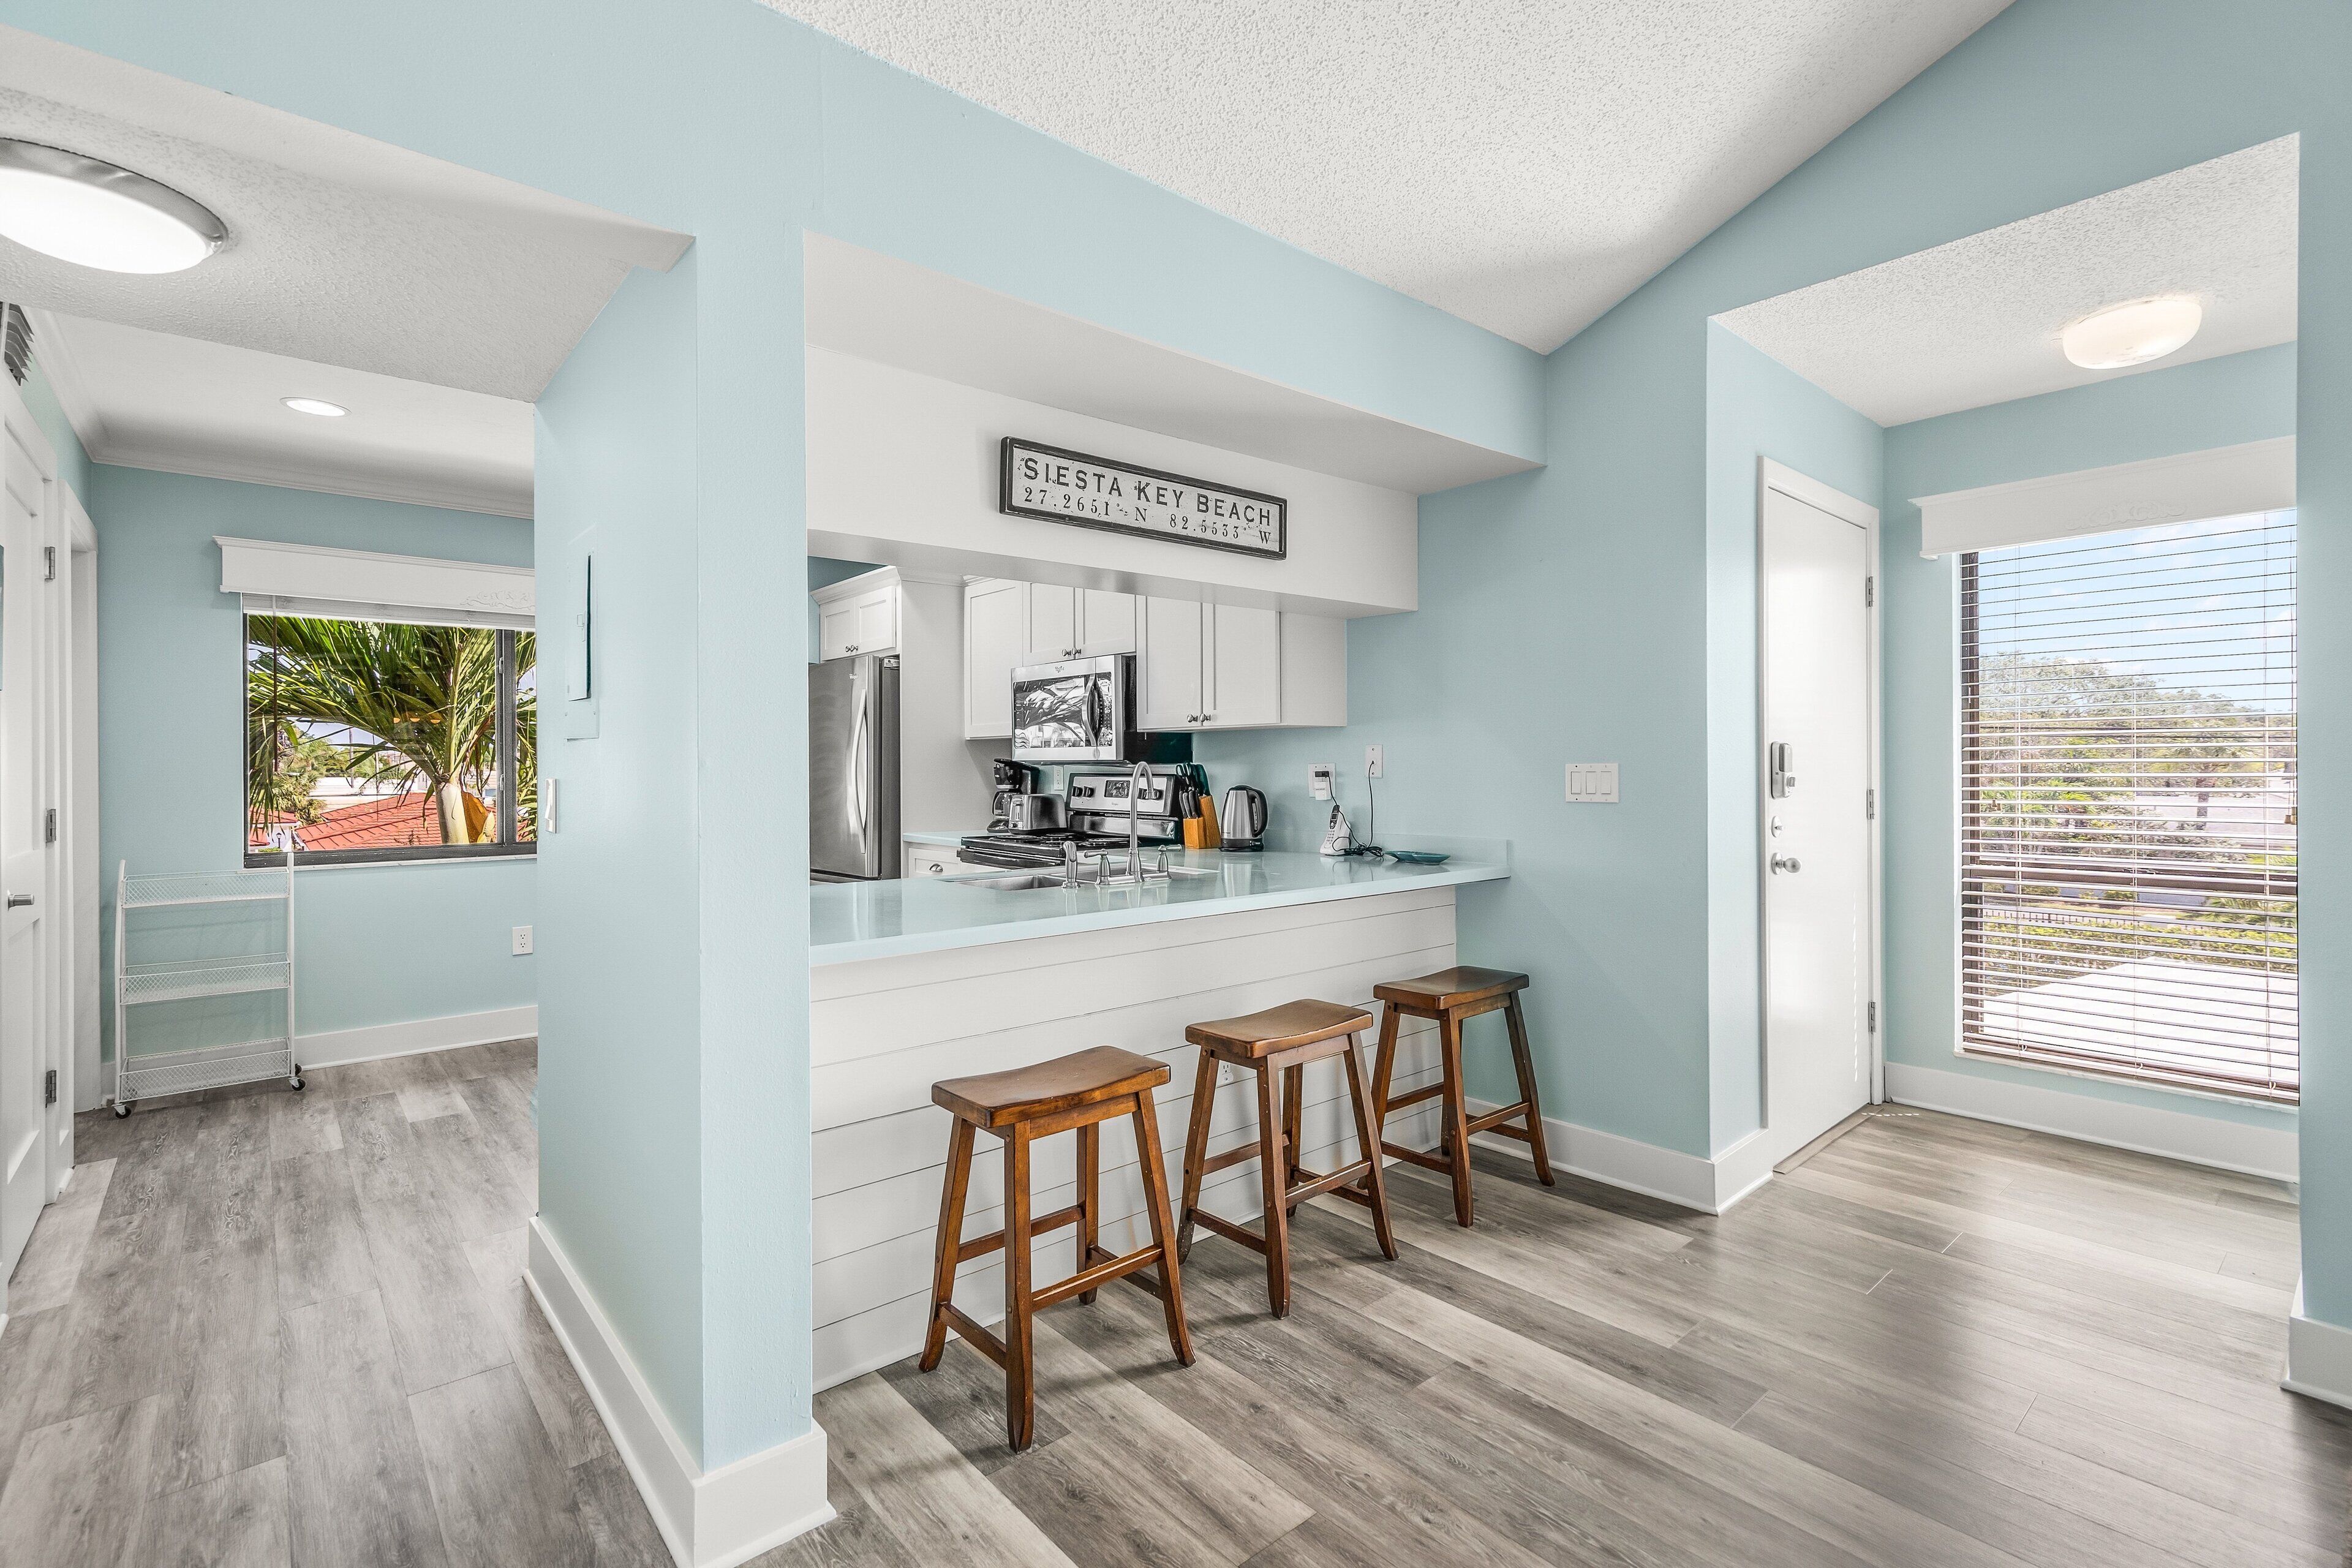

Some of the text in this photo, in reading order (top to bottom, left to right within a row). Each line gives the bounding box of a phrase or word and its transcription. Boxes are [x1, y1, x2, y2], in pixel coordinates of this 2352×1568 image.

[1023, 457, 1271, 526] SIESTA KEY BEACH
[1134, 507, 1148, 522] N
[1258, 530, 1272, 545] W
